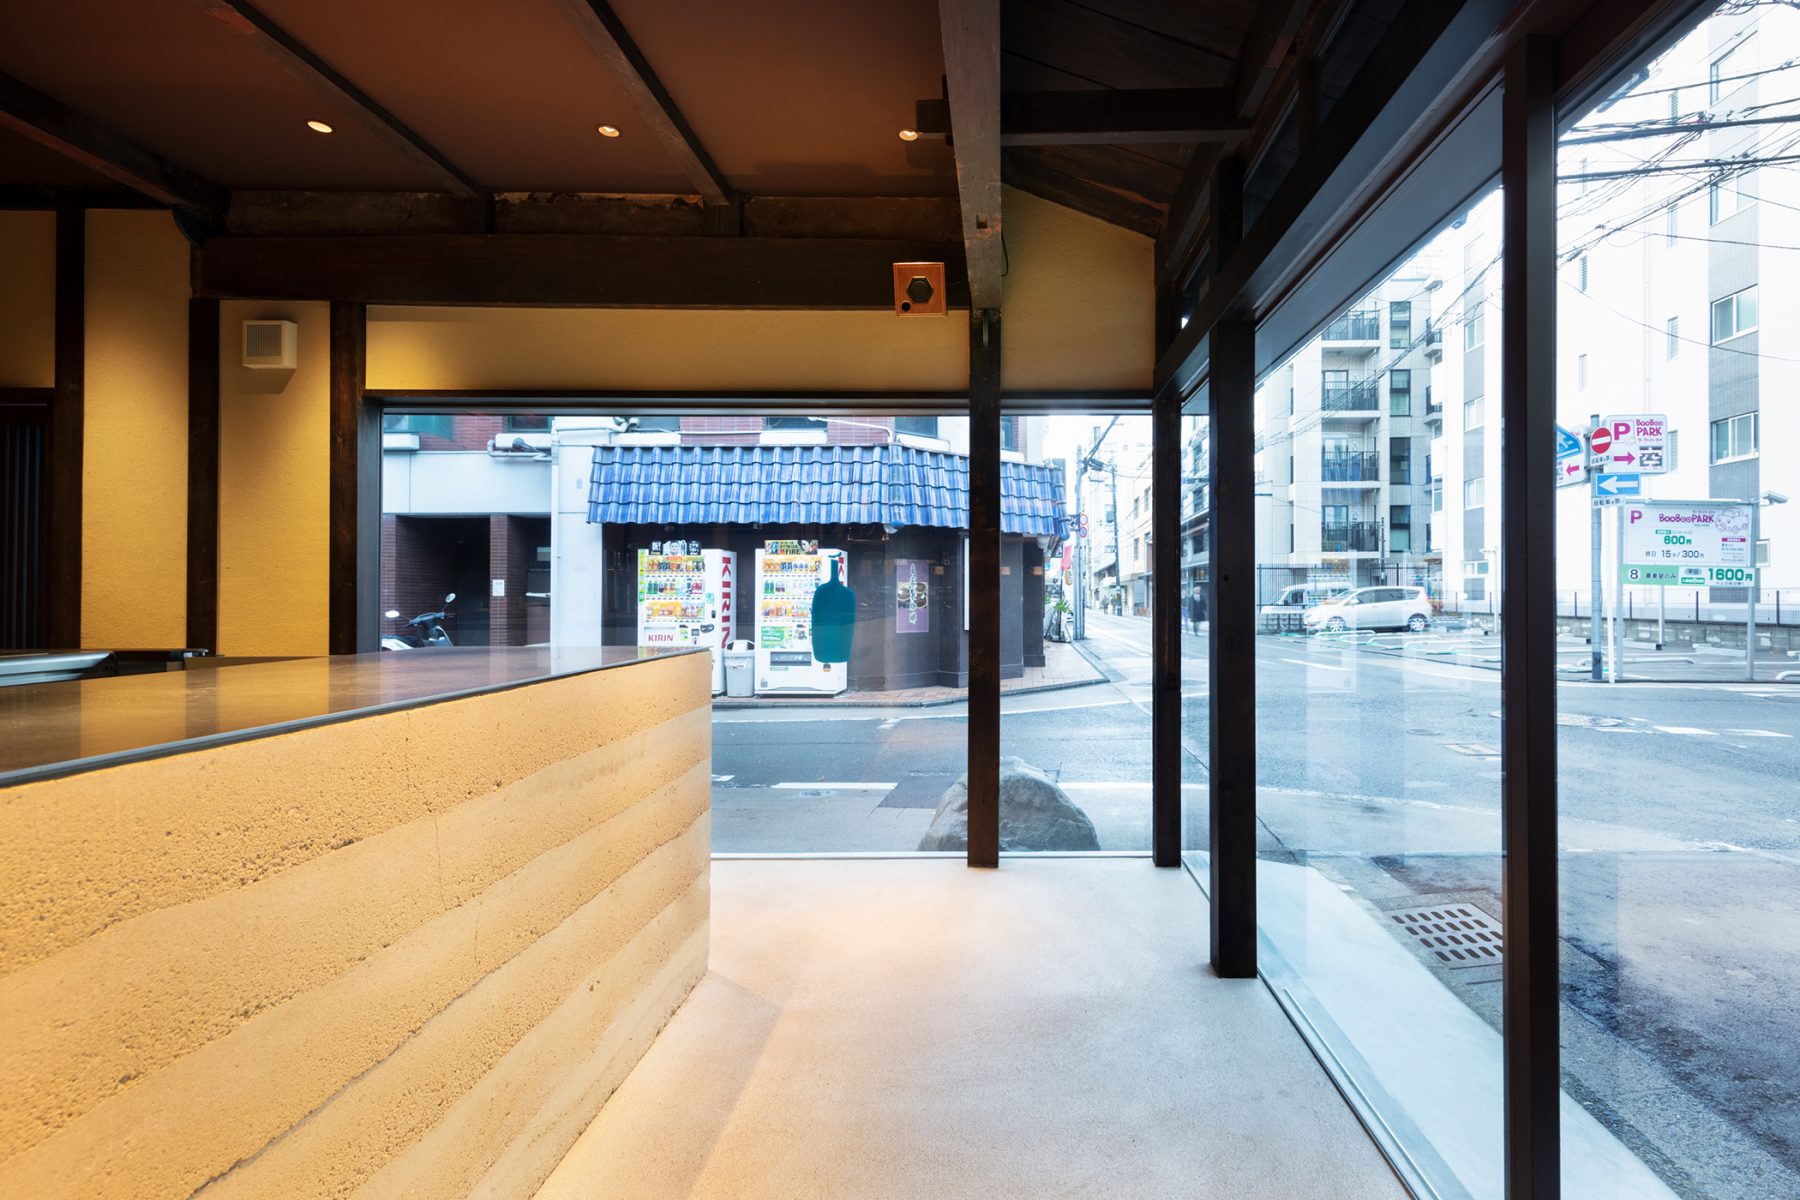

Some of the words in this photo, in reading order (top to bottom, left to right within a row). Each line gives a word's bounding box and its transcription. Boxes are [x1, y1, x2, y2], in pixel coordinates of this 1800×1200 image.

[1635, 418, 1664, 427] BooBoo
[1613, 422, 1631, 441] P
[1636, 427, 1663, 437] PARK
[1630, 510, 1643, 524] P
[1629, 568, 1639, 580] 8
[721, 556, 732, 649] KIRIN
[647, 634, 674, 642] KIRIN
